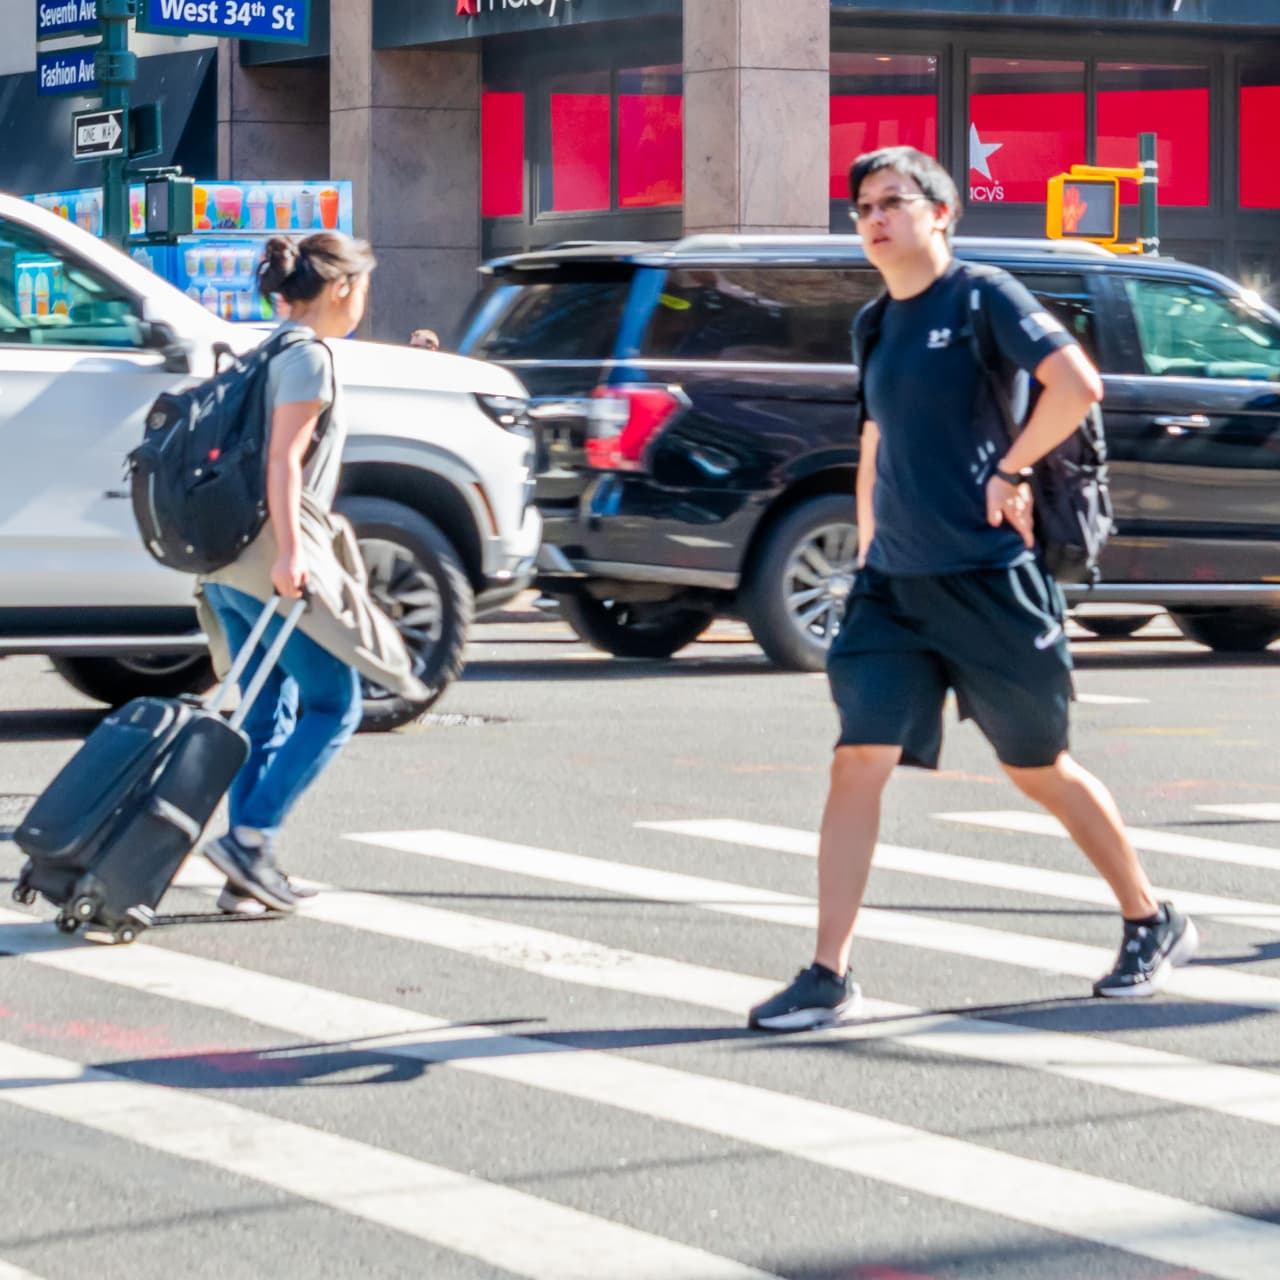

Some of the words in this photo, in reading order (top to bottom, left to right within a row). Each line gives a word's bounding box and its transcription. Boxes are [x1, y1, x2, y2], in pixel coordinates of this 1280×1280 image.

[223, 0, 265, 27] 34th
[271, 4, 295, 31] St
[41, 60, 77, 88] Fashion
[78, 59, 95, 83] Ave
[82, 127, 96, 143] ONE
[102, 125, 117, 140] WAY
